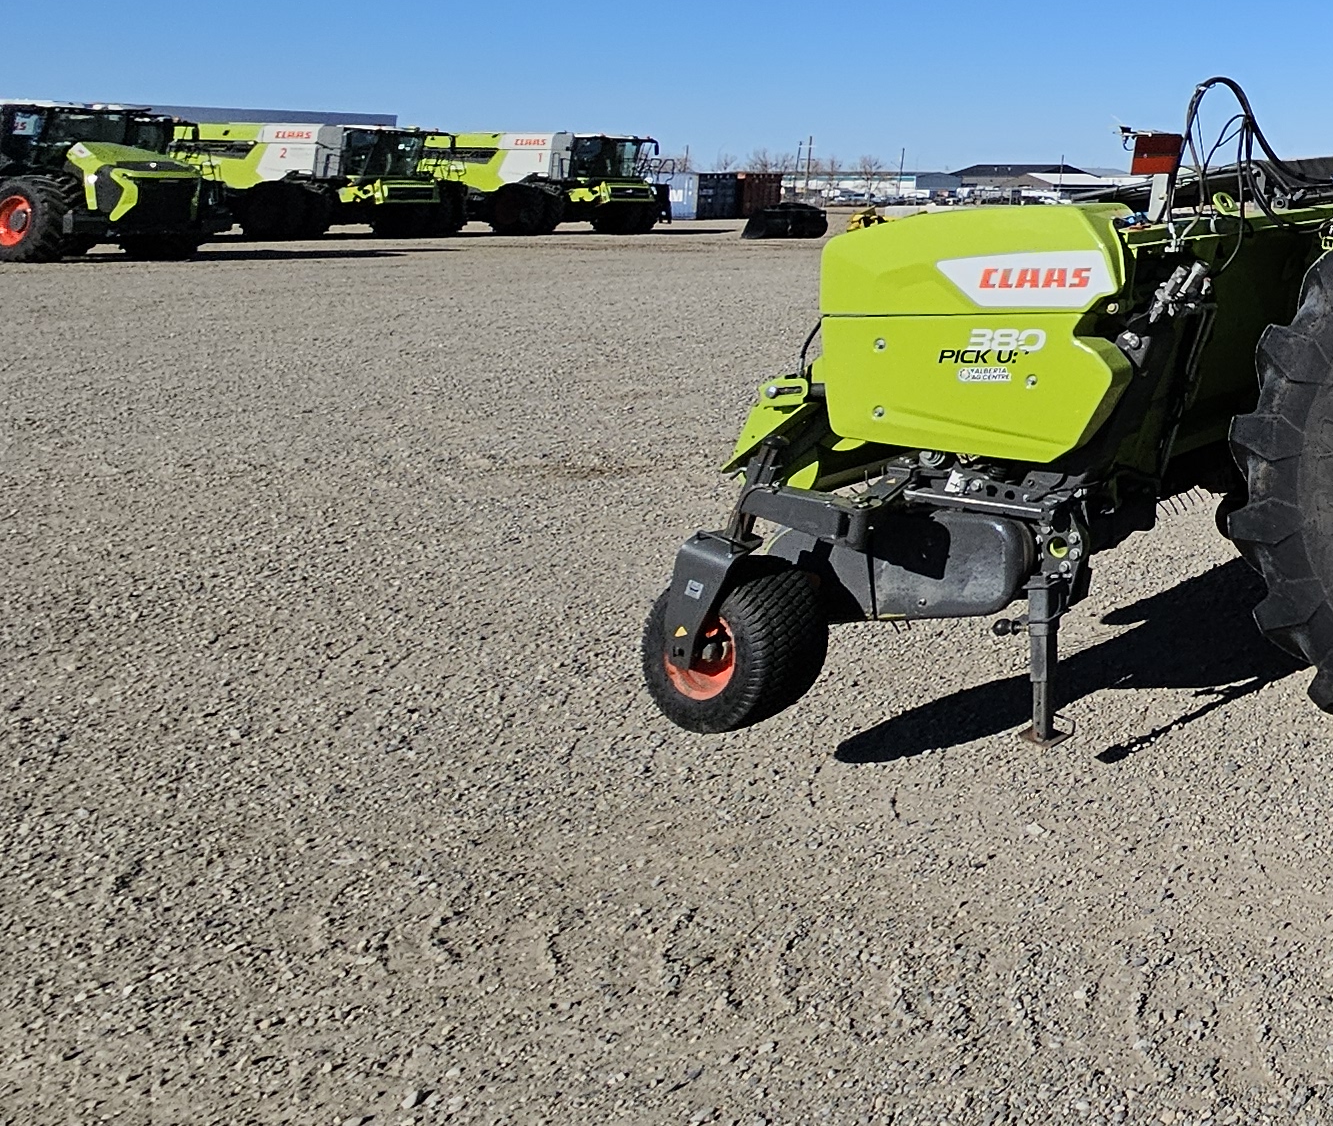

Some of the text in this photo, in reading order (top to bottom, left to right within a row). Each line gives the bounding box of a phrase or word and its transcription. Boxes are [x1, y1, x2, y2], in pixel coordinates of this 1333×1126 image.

[274, 130, 312, 139] CLAAS
[514, 138, 547, 146] CLAAS
[280, 147, 288, 159] 2
[538, 152, 543, 163] 1
[979, 267, 1092, 289] CLAAS
[967, 328, 1046, 352] 380
[938, 349, 1018, 364] PICK U
